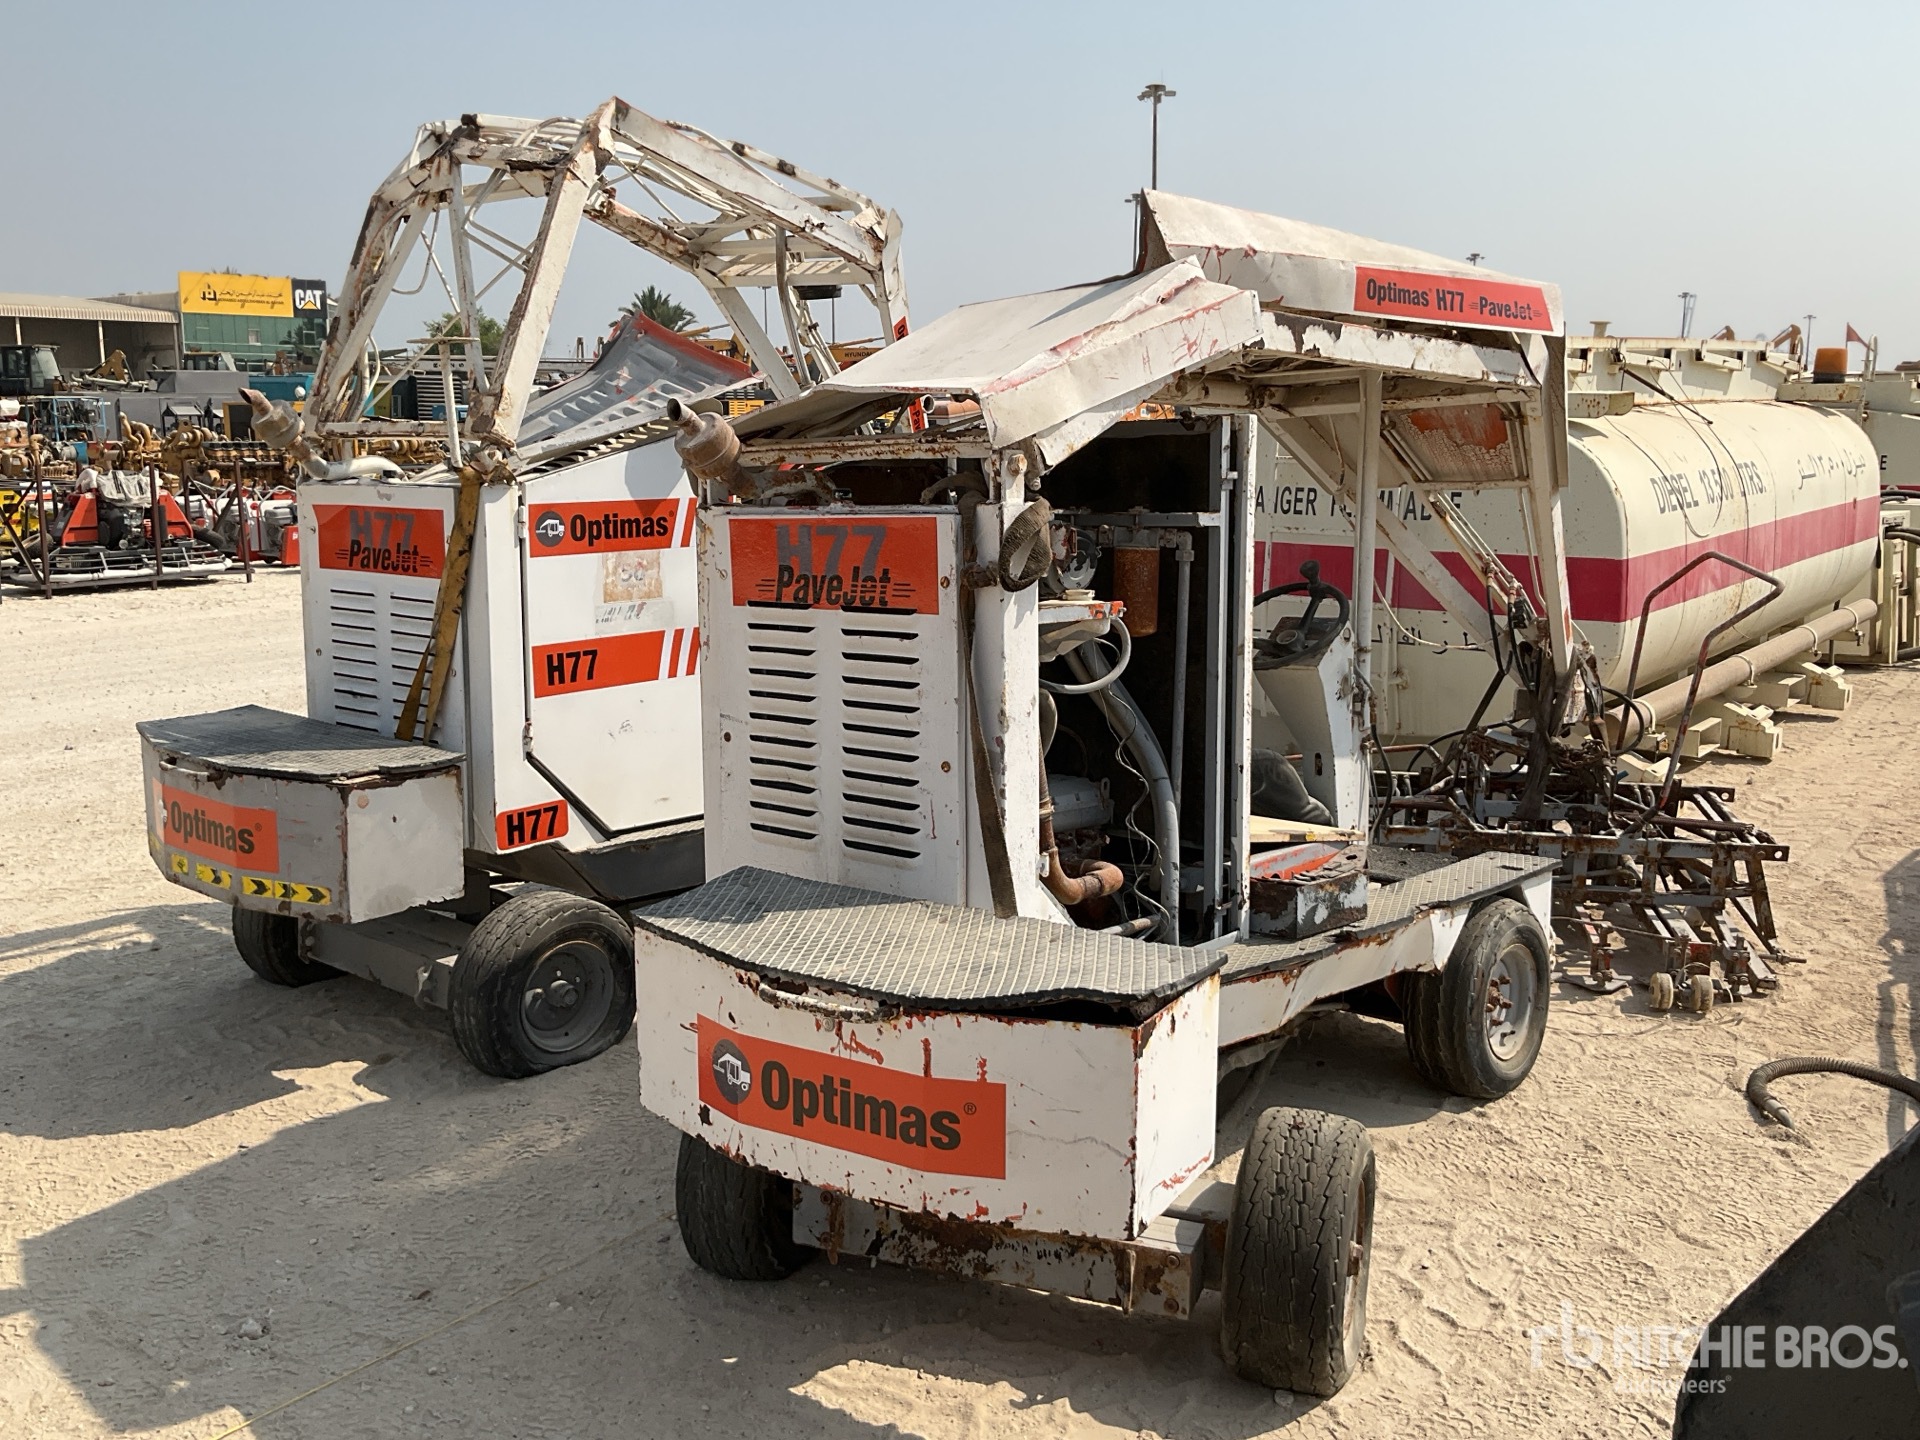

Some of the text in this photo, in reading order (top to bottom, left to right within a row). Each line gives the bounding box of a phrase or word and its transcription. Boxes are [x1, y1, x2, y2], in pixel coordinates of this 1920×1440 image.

[295, 289, 322, 310] CAT
[1436, 288, 1464, 313] H77
[1479, 296, 1533, 321] PaveJet
[1650, 472, 1699, 515] DIESEL
[349, 509, 415, 552] H77
[348, 538, 419, 573] PaveJet
[777, 524, 887, 580] H77
[775, 564, 891, 607] PaveJet
[546, 649, 598, 686] H77
[506, 804, 559, 846] H77
